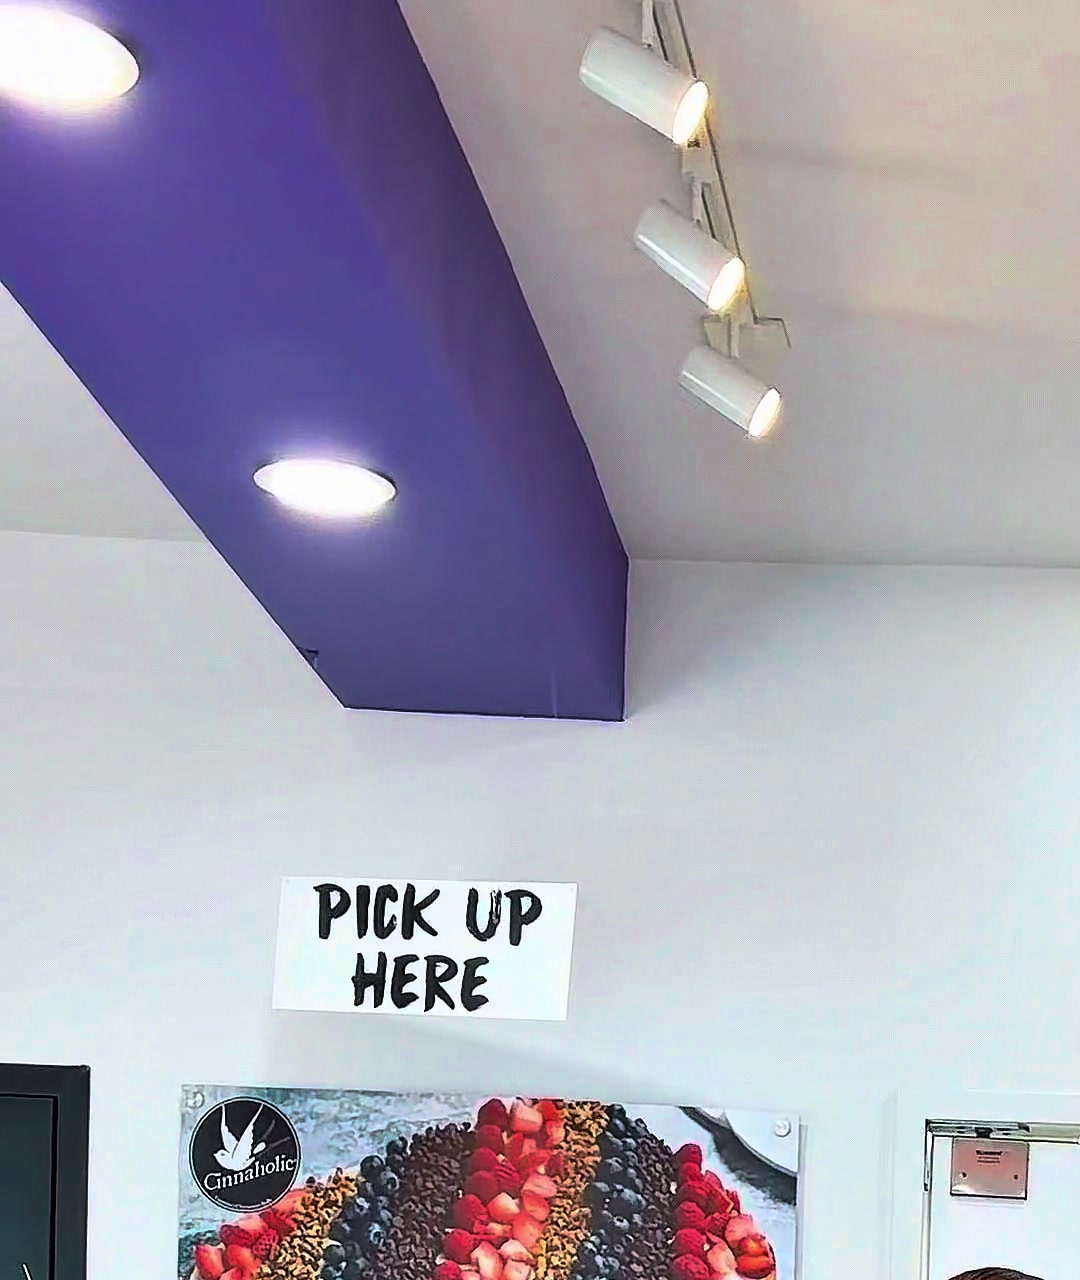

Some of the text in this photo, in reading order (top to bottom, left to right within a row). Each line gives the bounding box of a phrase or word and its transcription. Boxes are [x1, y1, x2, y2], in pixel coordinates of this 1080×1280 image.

[313, 883, 542, 946] PICK UP
[351, 951, 489, 1012] HERE
[204, 1154, 297, 1190] Cinnaholic
